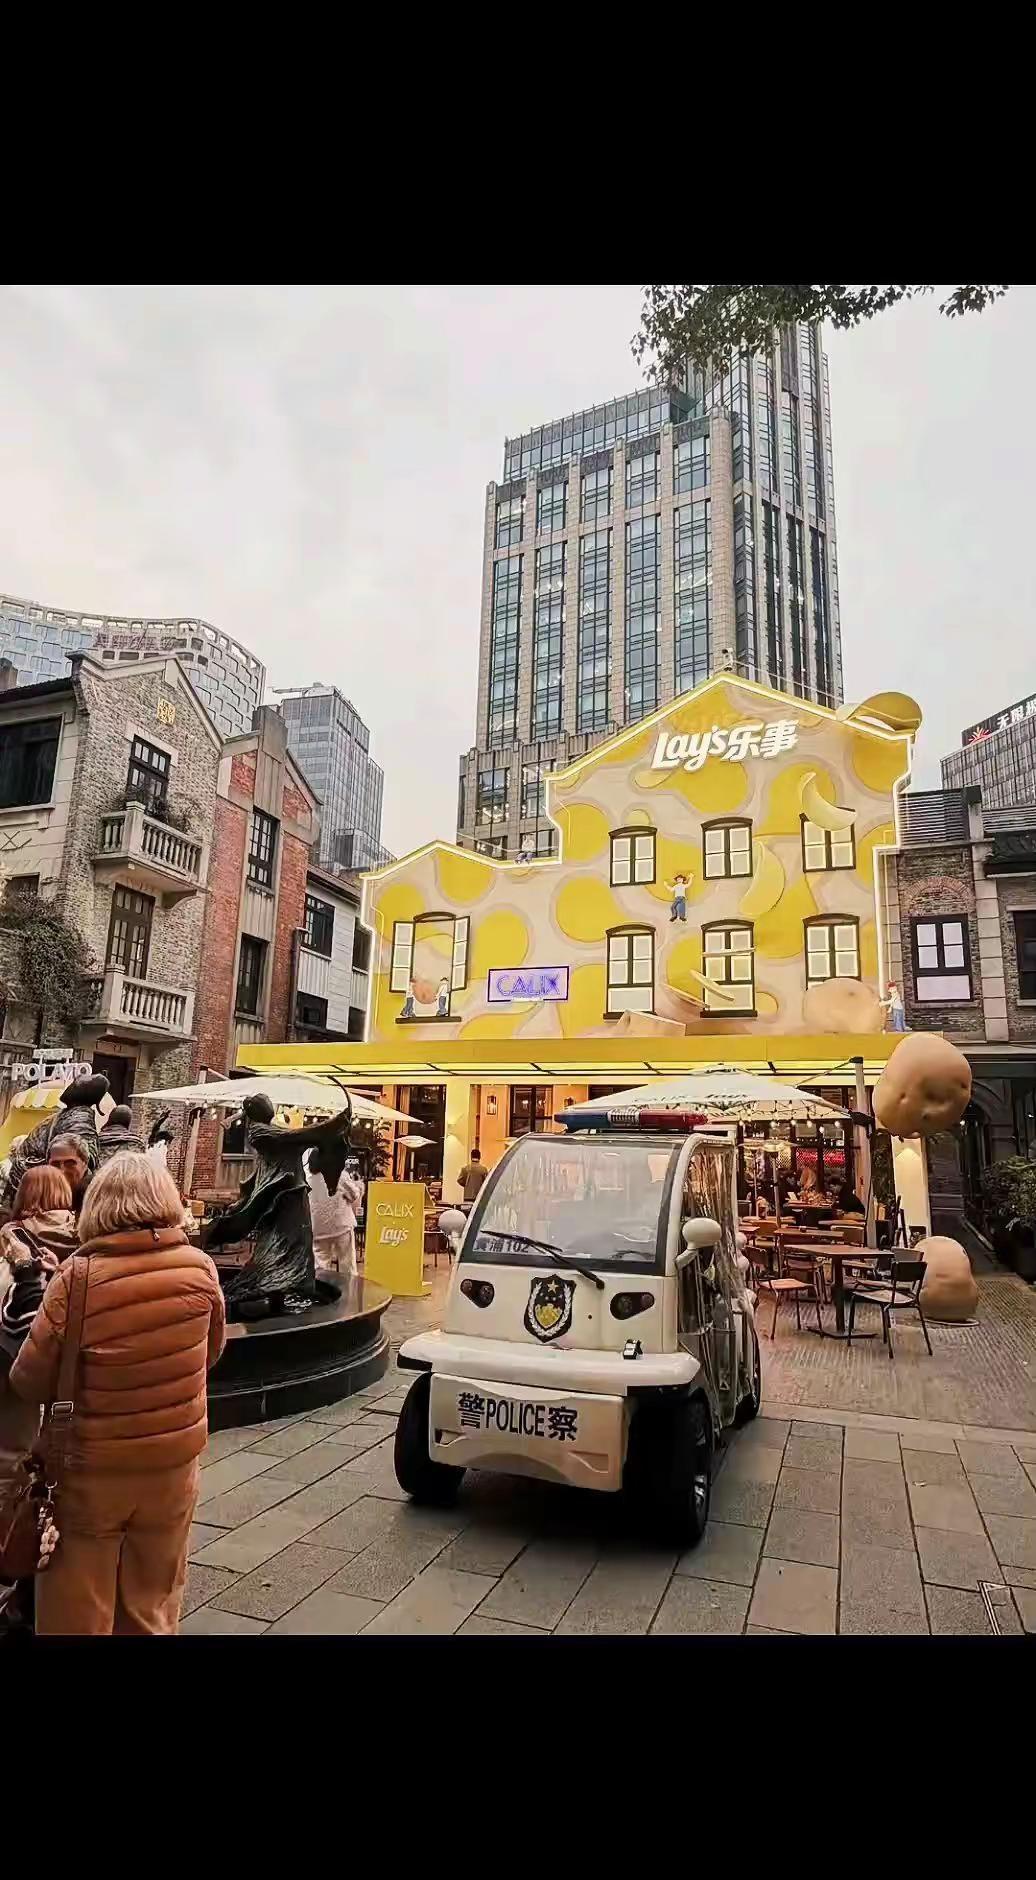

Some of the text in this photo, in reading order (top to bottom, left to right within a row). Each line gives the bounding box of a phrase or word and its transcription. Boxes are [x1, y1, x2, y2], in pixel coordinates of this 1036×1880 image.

[497, 974, 561, 996] CALIX
[376, 1203, 414, 1217] CALIX
[380, 1226, 409, 1247] Lay's
